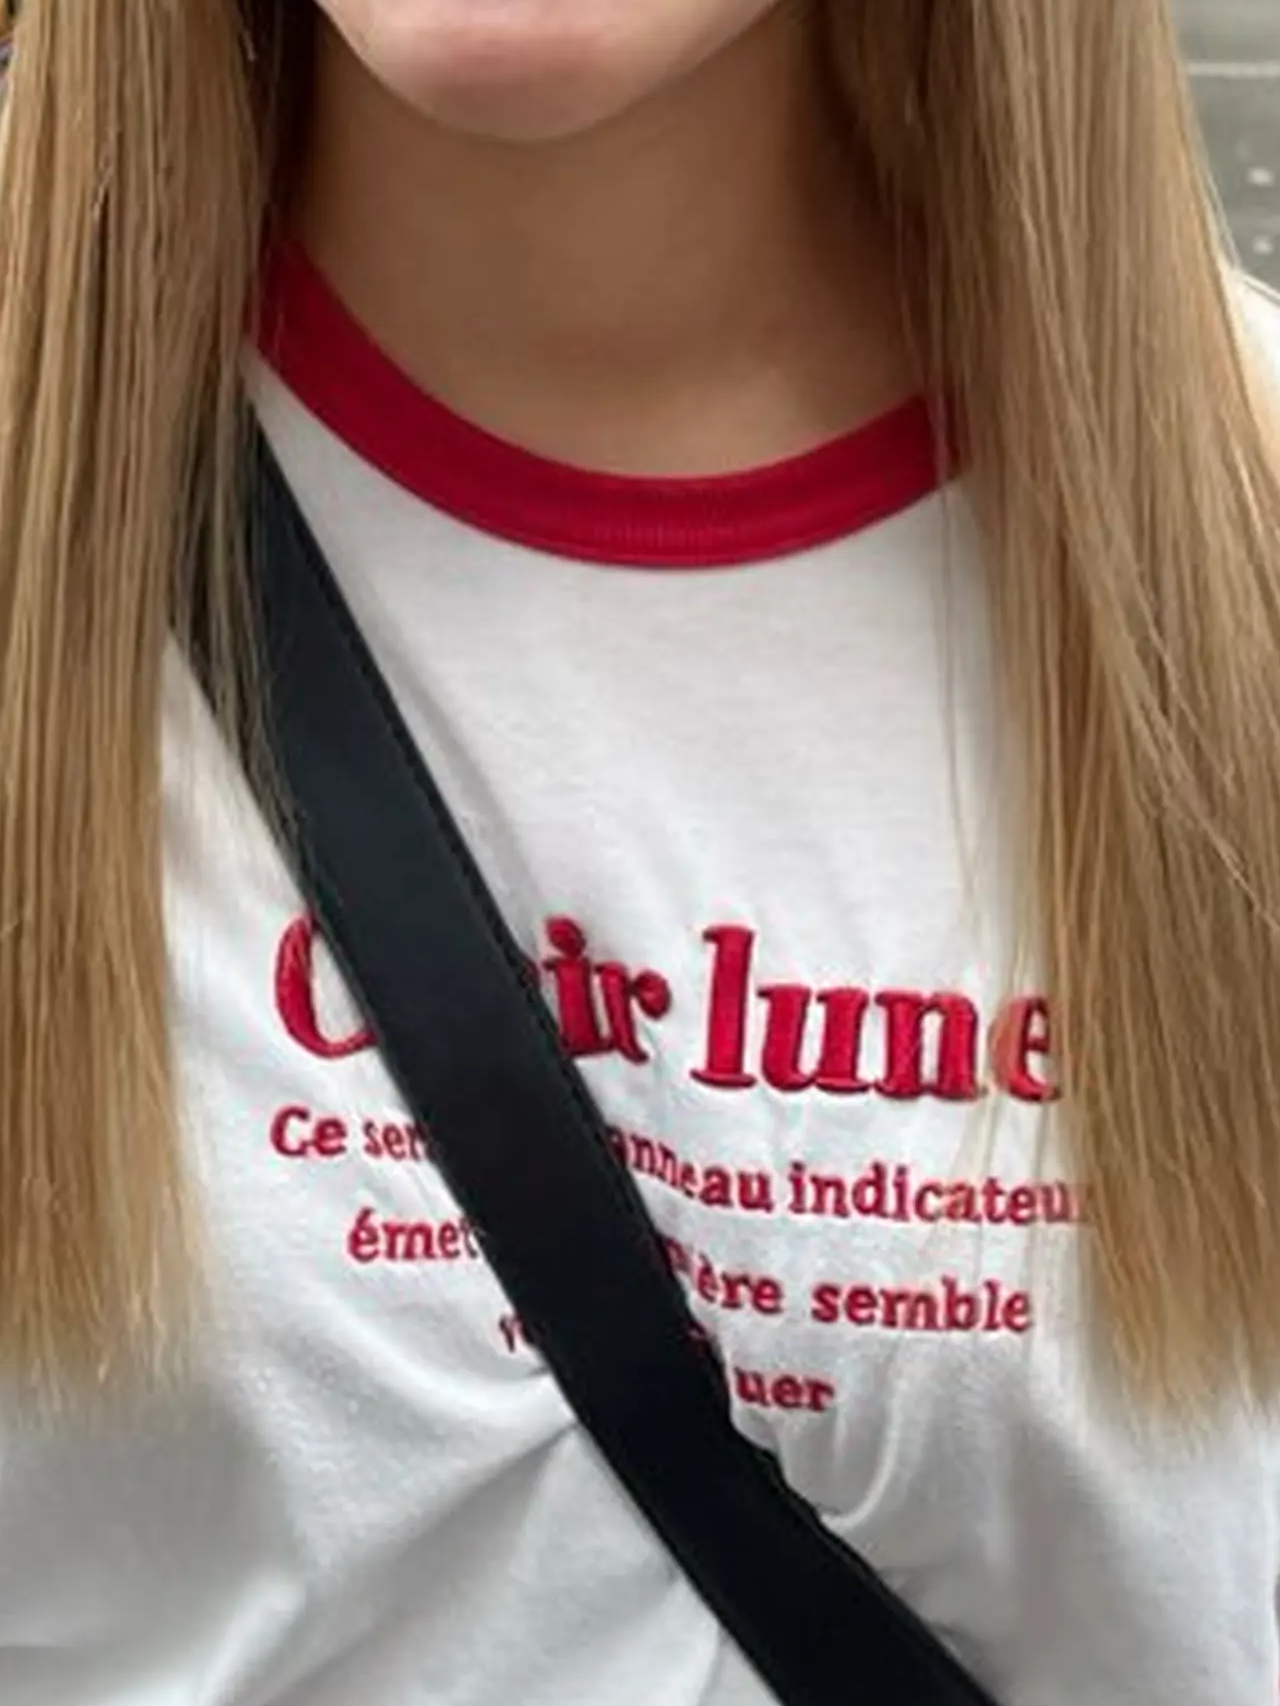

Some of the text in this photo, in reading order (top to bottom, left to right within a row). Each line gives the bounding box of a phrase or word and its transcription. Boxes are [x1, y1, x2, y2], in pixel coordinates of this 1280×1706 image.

[690, 925, 1061, 1103] lune
[271, 1106, 347, 1157] Ce
[810, 1278, 1034, 1334] semble
